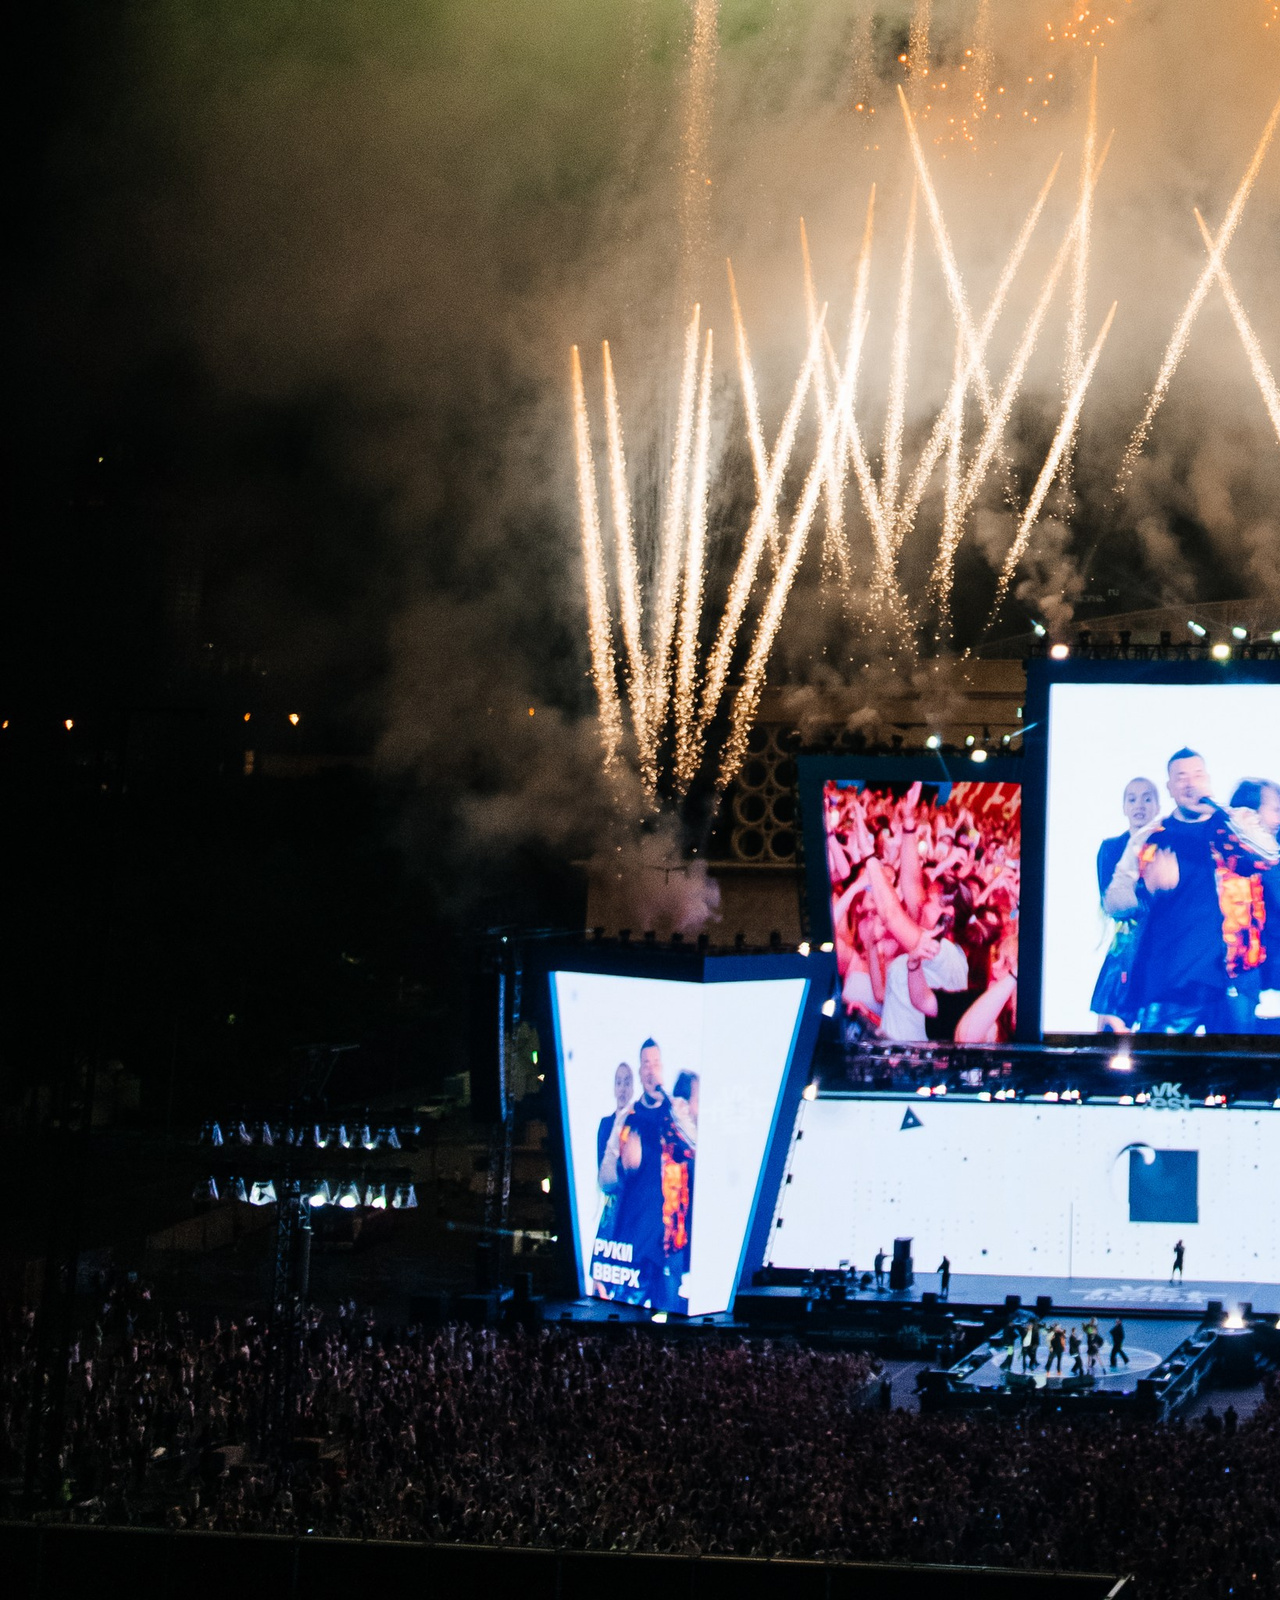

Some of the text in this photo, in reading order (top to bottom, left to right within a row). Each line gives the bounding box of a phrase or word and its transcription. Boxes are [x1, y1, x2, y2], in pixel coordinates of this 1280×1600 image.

[1151, 1082, 1182, 1098] VK
[594, 1237, 633, 1263] РУКИ
[592, 1261, 640, 1289] ВВЕРХ
